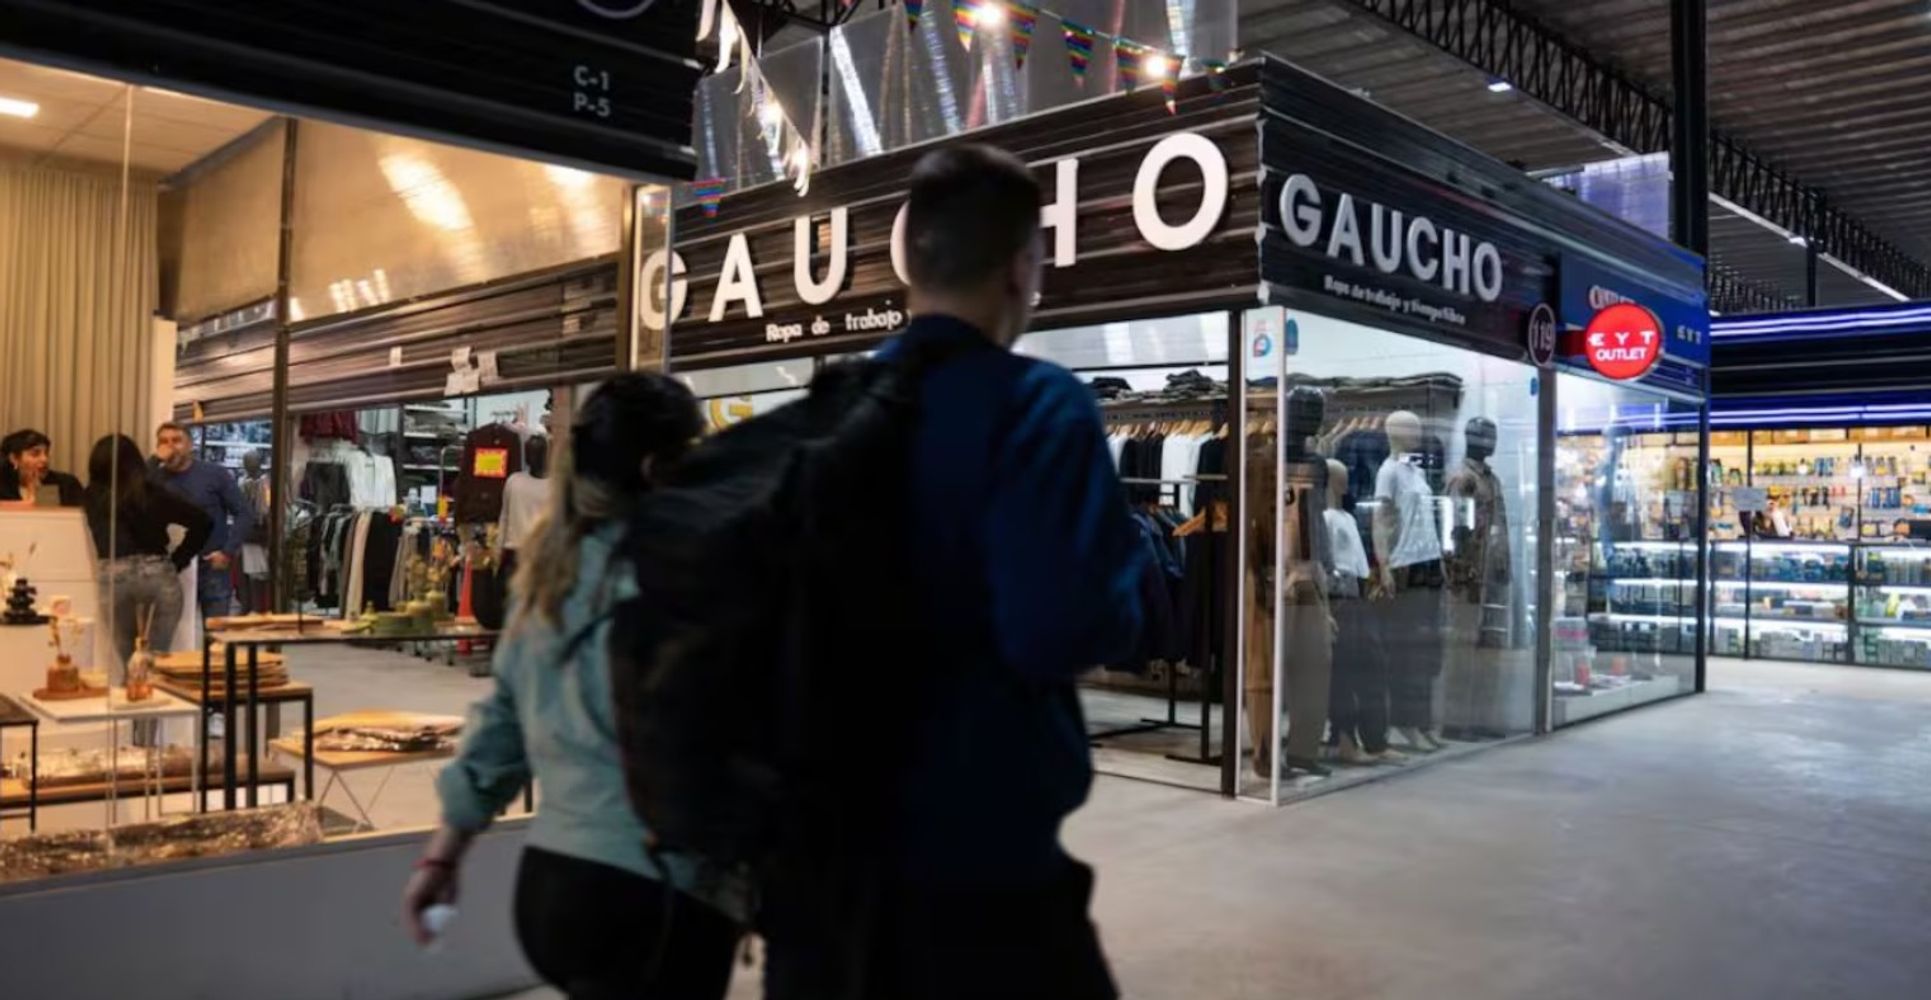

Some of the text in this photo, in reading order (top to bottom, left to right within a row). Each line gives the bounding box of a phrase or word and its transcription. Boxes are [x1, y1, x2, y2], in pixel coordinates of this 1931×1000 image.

[574, 65, 609, 91] C-1
[574, 91, 610, 117] P-5
[639, 132, 1228, 330] GAUHO
[1279, 173, 1503, 301] GAUCHO
[765, 323, 802, 343] Ropa
[811, 315, 830, 335] de
[845, 300, 903, 331] trabajo
[1532, 320, 1553, 352] 119
[1595, 347, 1648, 361] OUTLET
